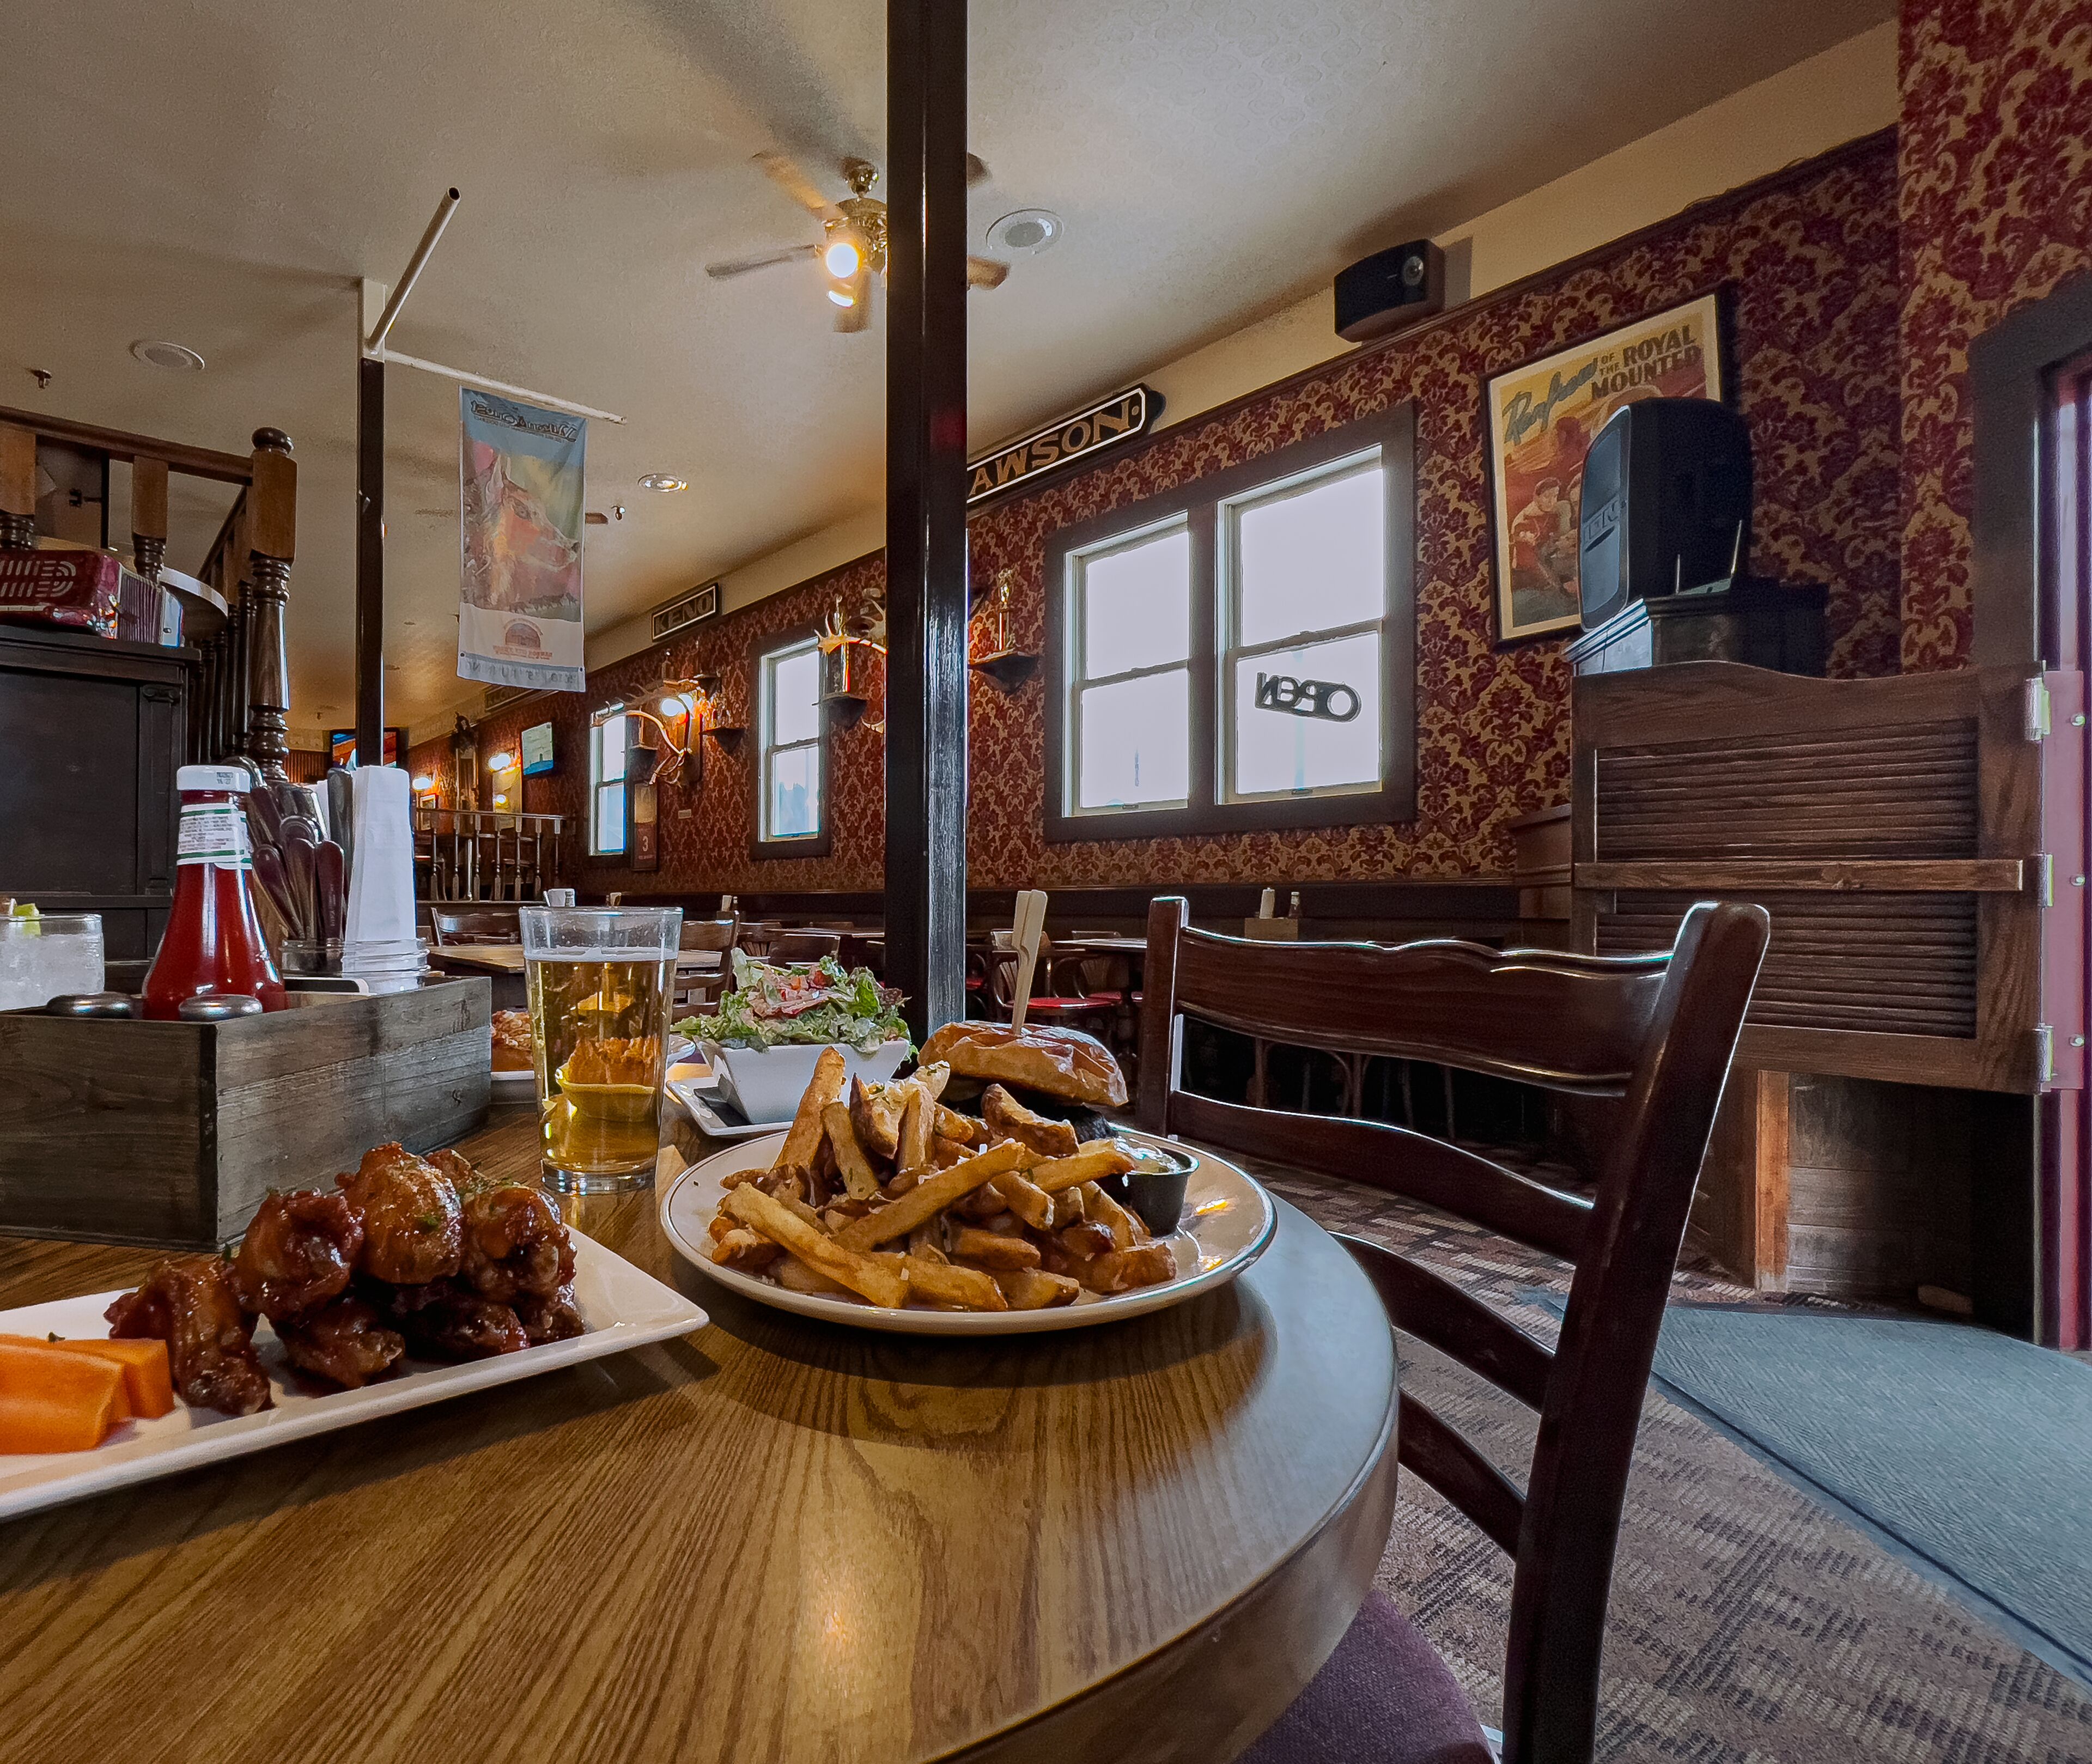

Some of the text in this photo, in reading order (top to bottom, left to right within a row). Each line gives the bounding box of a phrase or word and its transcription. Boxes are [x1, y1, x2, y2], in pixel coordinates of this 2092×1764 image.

[1601, 352, 1615, 366] OF
[1622, 325, 1698, 368] ROYAL
[1591, 345, 1703, 399] MOUNTED
[1599, 361, 1620, 378] THE
[969, 398, 1130, 497] AWSON
[655, 594, 712, 634] KENO
